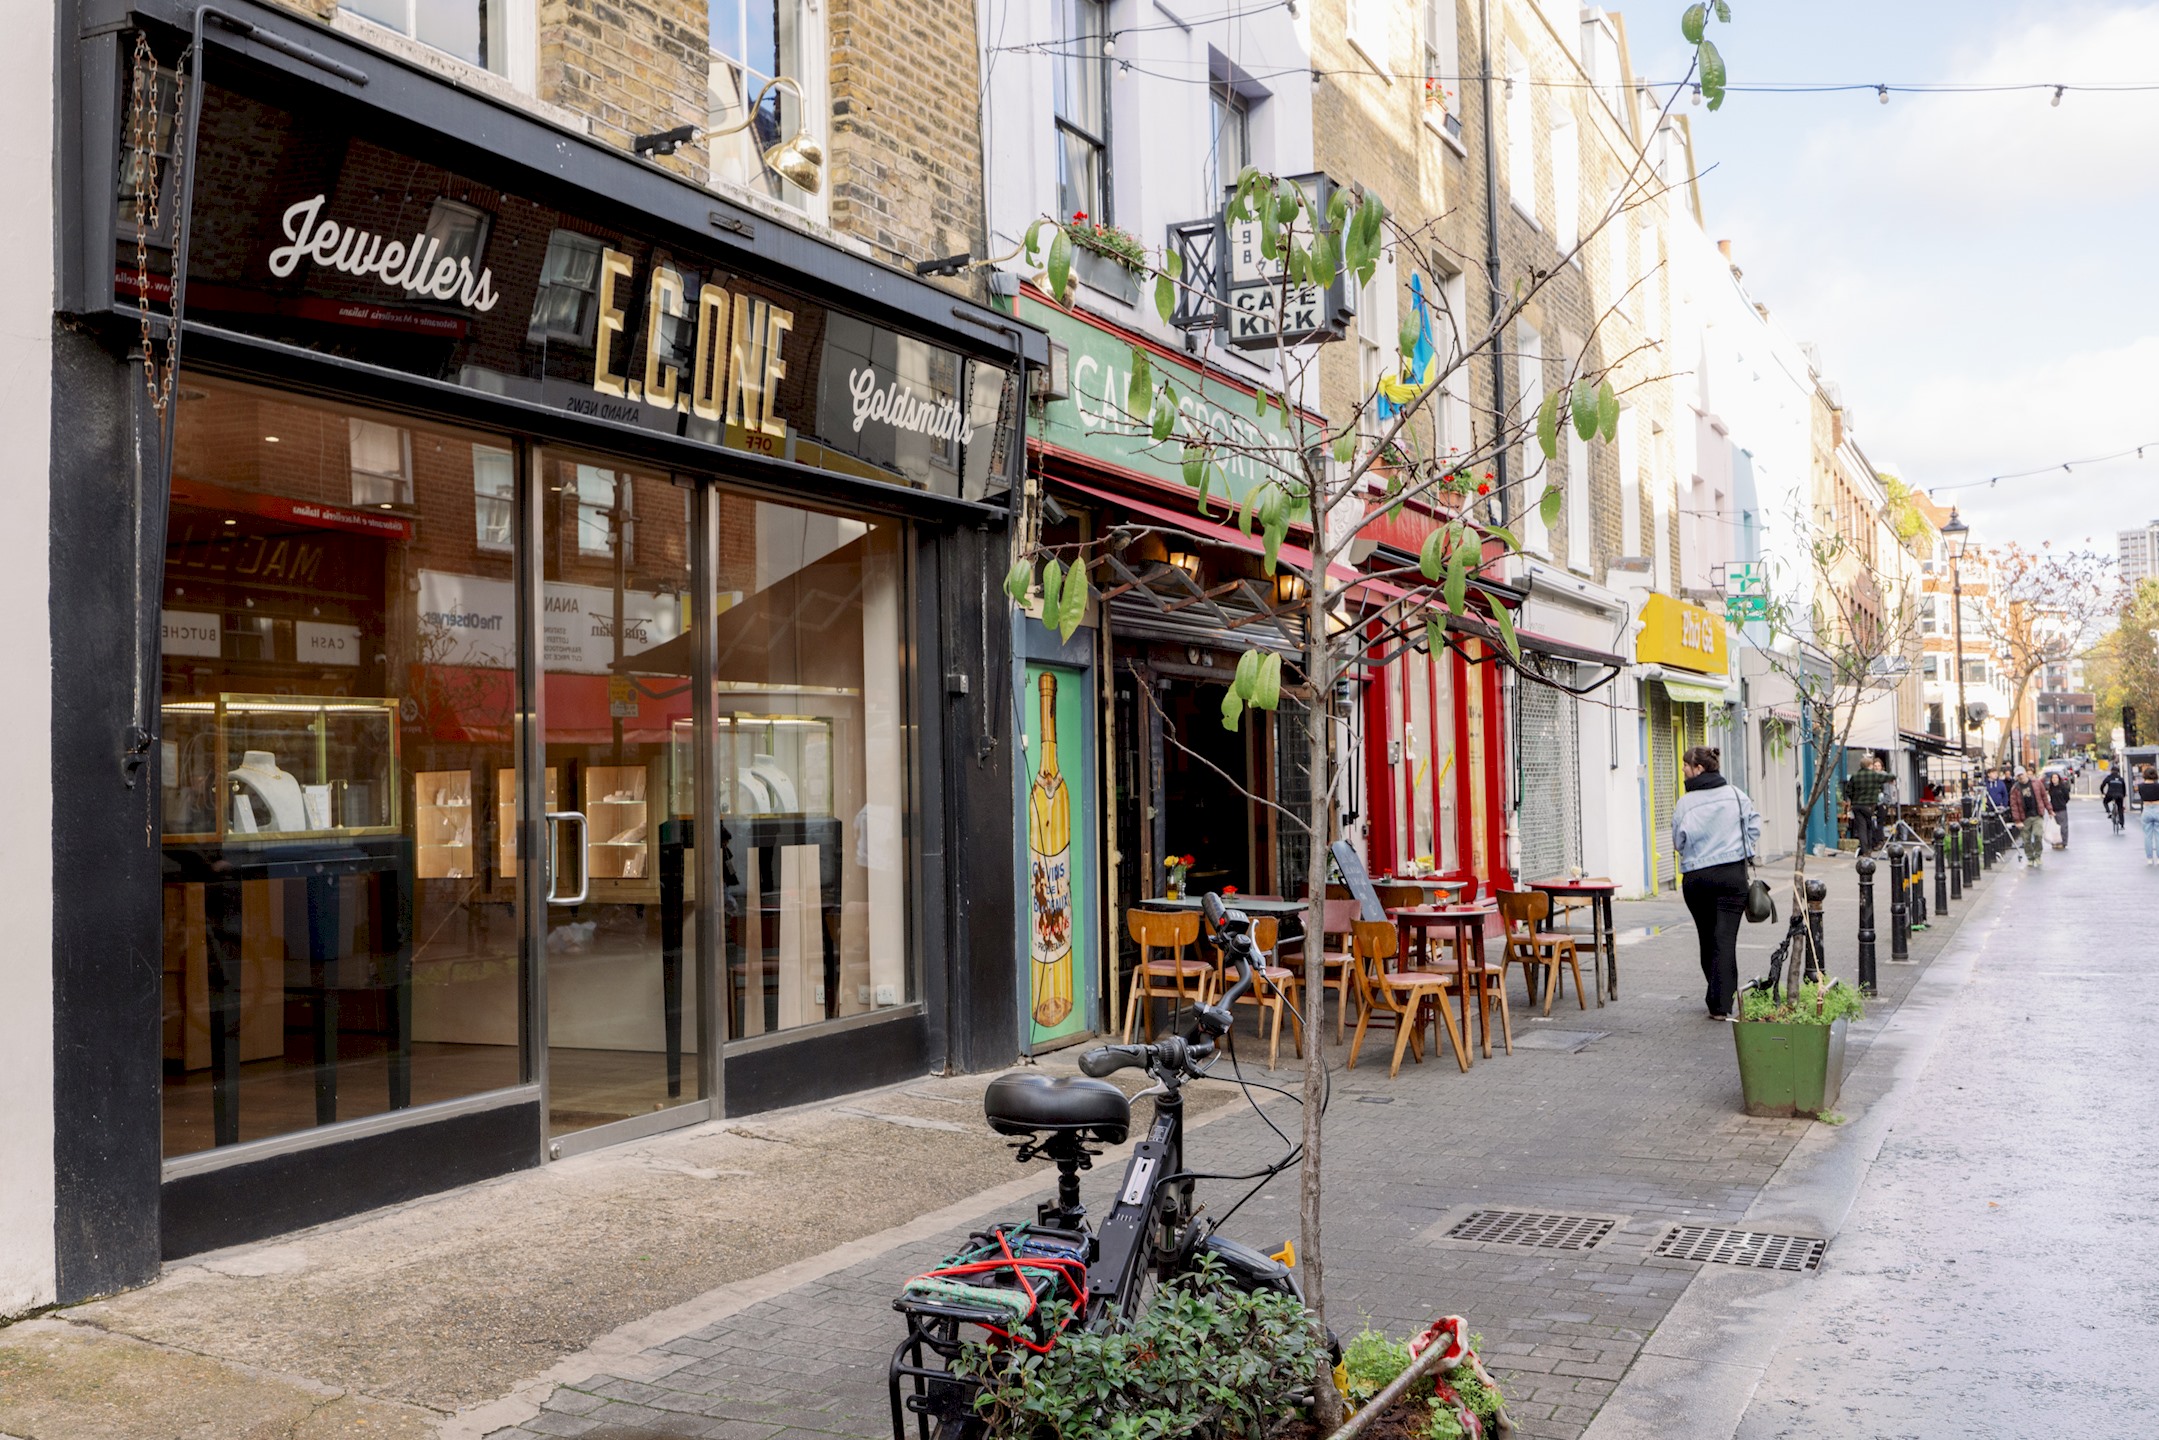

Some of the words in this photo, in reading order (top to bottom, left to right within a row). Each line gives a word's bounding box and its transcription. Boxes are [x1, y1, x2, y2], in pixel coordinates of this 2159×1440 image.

[1243, 230, 1251, 244] 9
[269, 194, 499, 312] Jewellers
[1244, 250, 1252, 264] 8
[1239, 309, 1316, 336] KICK
[849, 367, 974, 445] Goldsmiths
